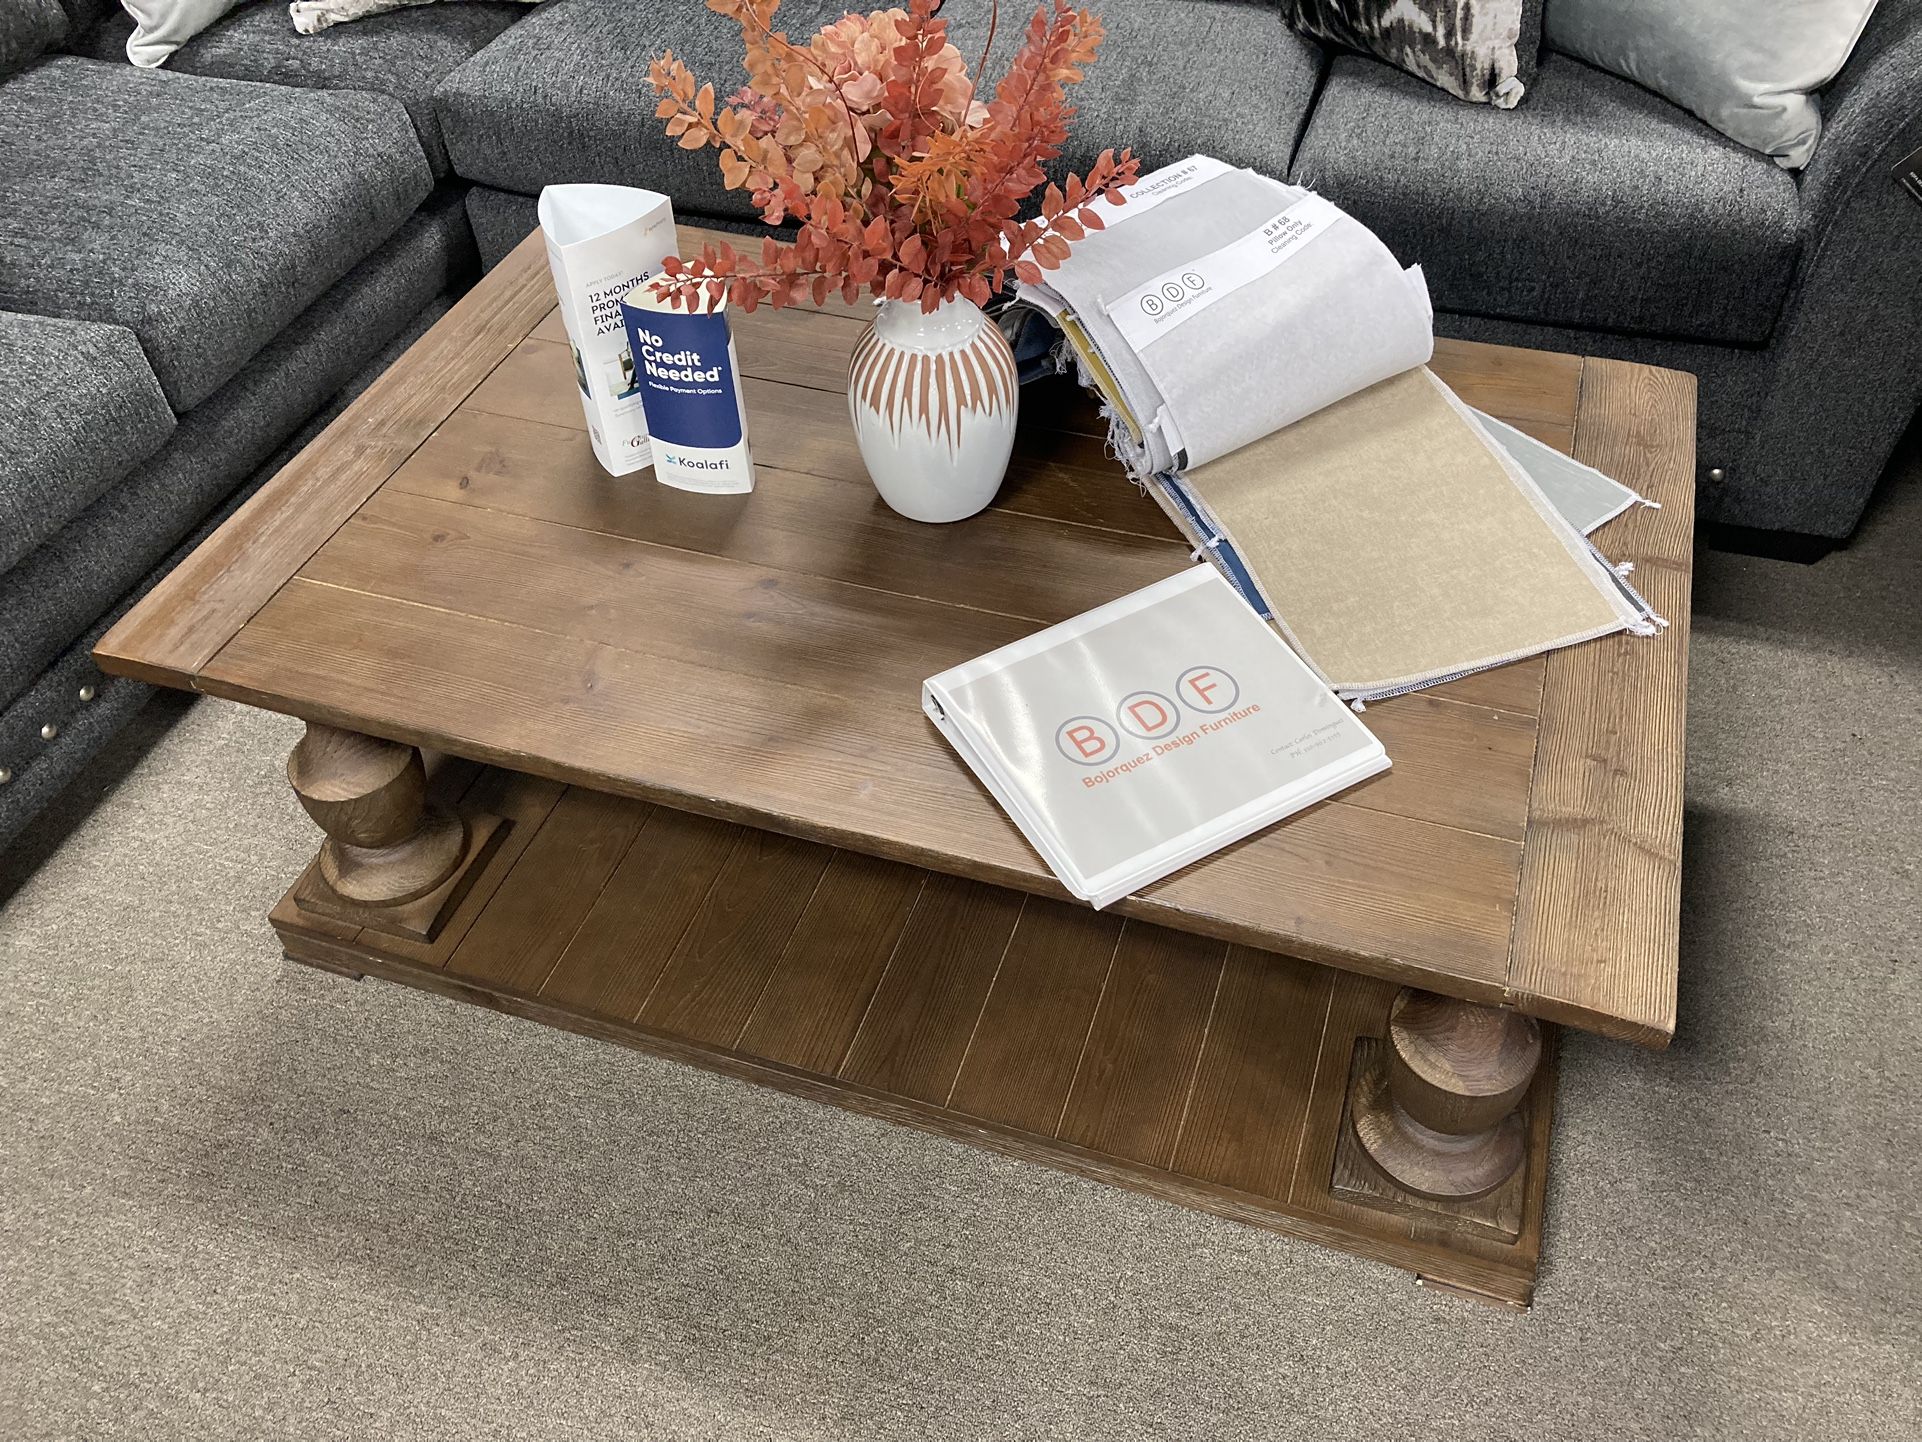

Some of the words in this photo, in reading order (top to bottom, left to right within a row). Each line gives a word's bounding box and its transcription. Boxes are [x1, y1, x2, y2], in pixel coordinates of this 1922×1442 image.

[1130, 173, 1182, 198] COLLECTION
[1263, 228, 1273, 236] B
[1277, 216, 1290, 225] 68
[1268, 230, 1288, 245] Pillow
[1286, 220, 1302, 232] Only
[1271, 234, 1298, 253] Cleaning
[588, 292, 601, 303] 12
[603, 271, 650, 299] MONTHS
[591, 295, 627, 314] PROM
[1177, 297, 1194, 311] Design
[637, 327, 663, 347] No
[641, 345, 702, 367] Credit
[669, 386, 696, 394] Payment
[678, 456, 729, 470] Koalafi
[1082, 751, 1154, 789] Bojorquez
[1153, 730, 1200, 757] Design
[1199, 702, 1261, 736] Furniture
